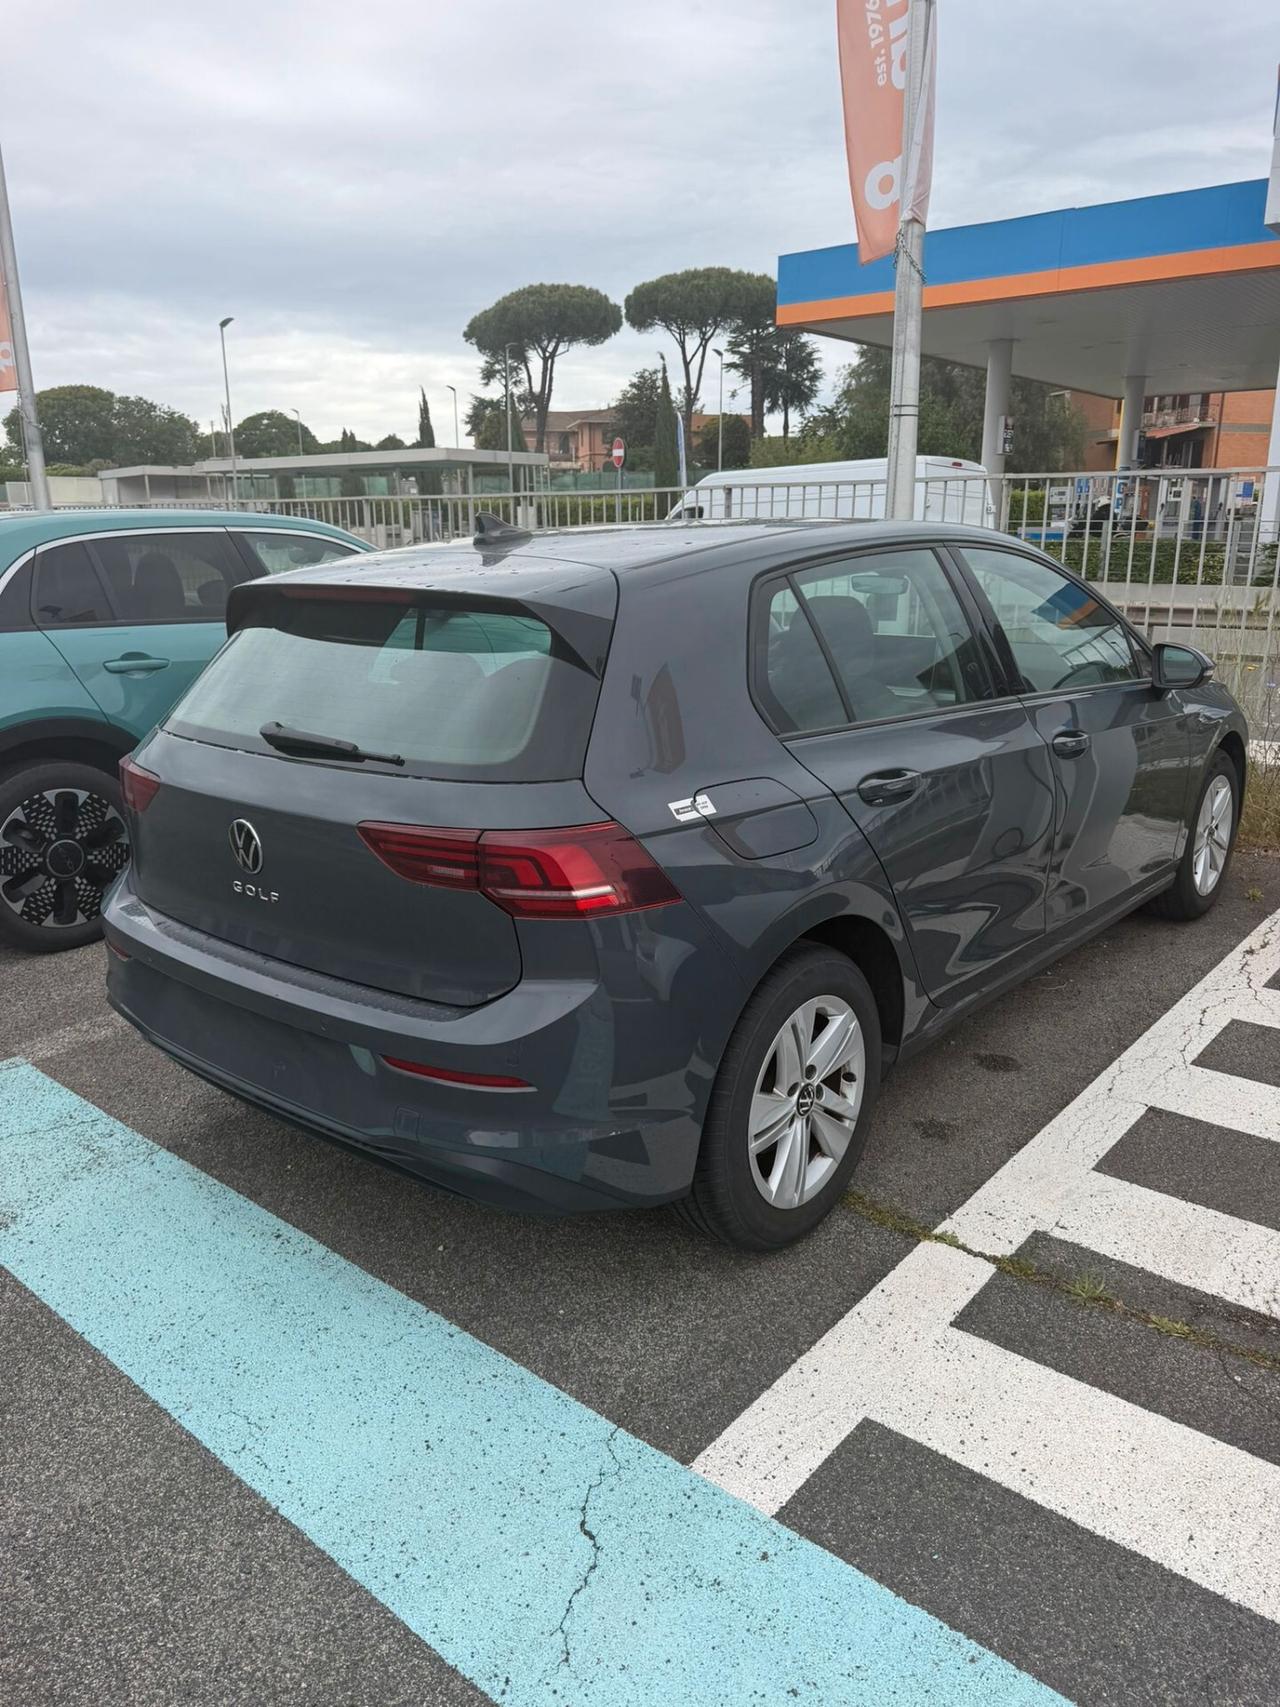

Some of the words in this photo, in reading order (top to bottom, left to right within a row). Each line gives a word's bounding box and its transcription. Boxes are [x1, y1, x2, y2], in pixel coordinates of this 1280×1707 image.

[865, 0, 884, 48] 1976
[874, 48, 888, 87] est.
[229, 819, 263, 874] VW
[232, 880, 280, 903] GOLF
